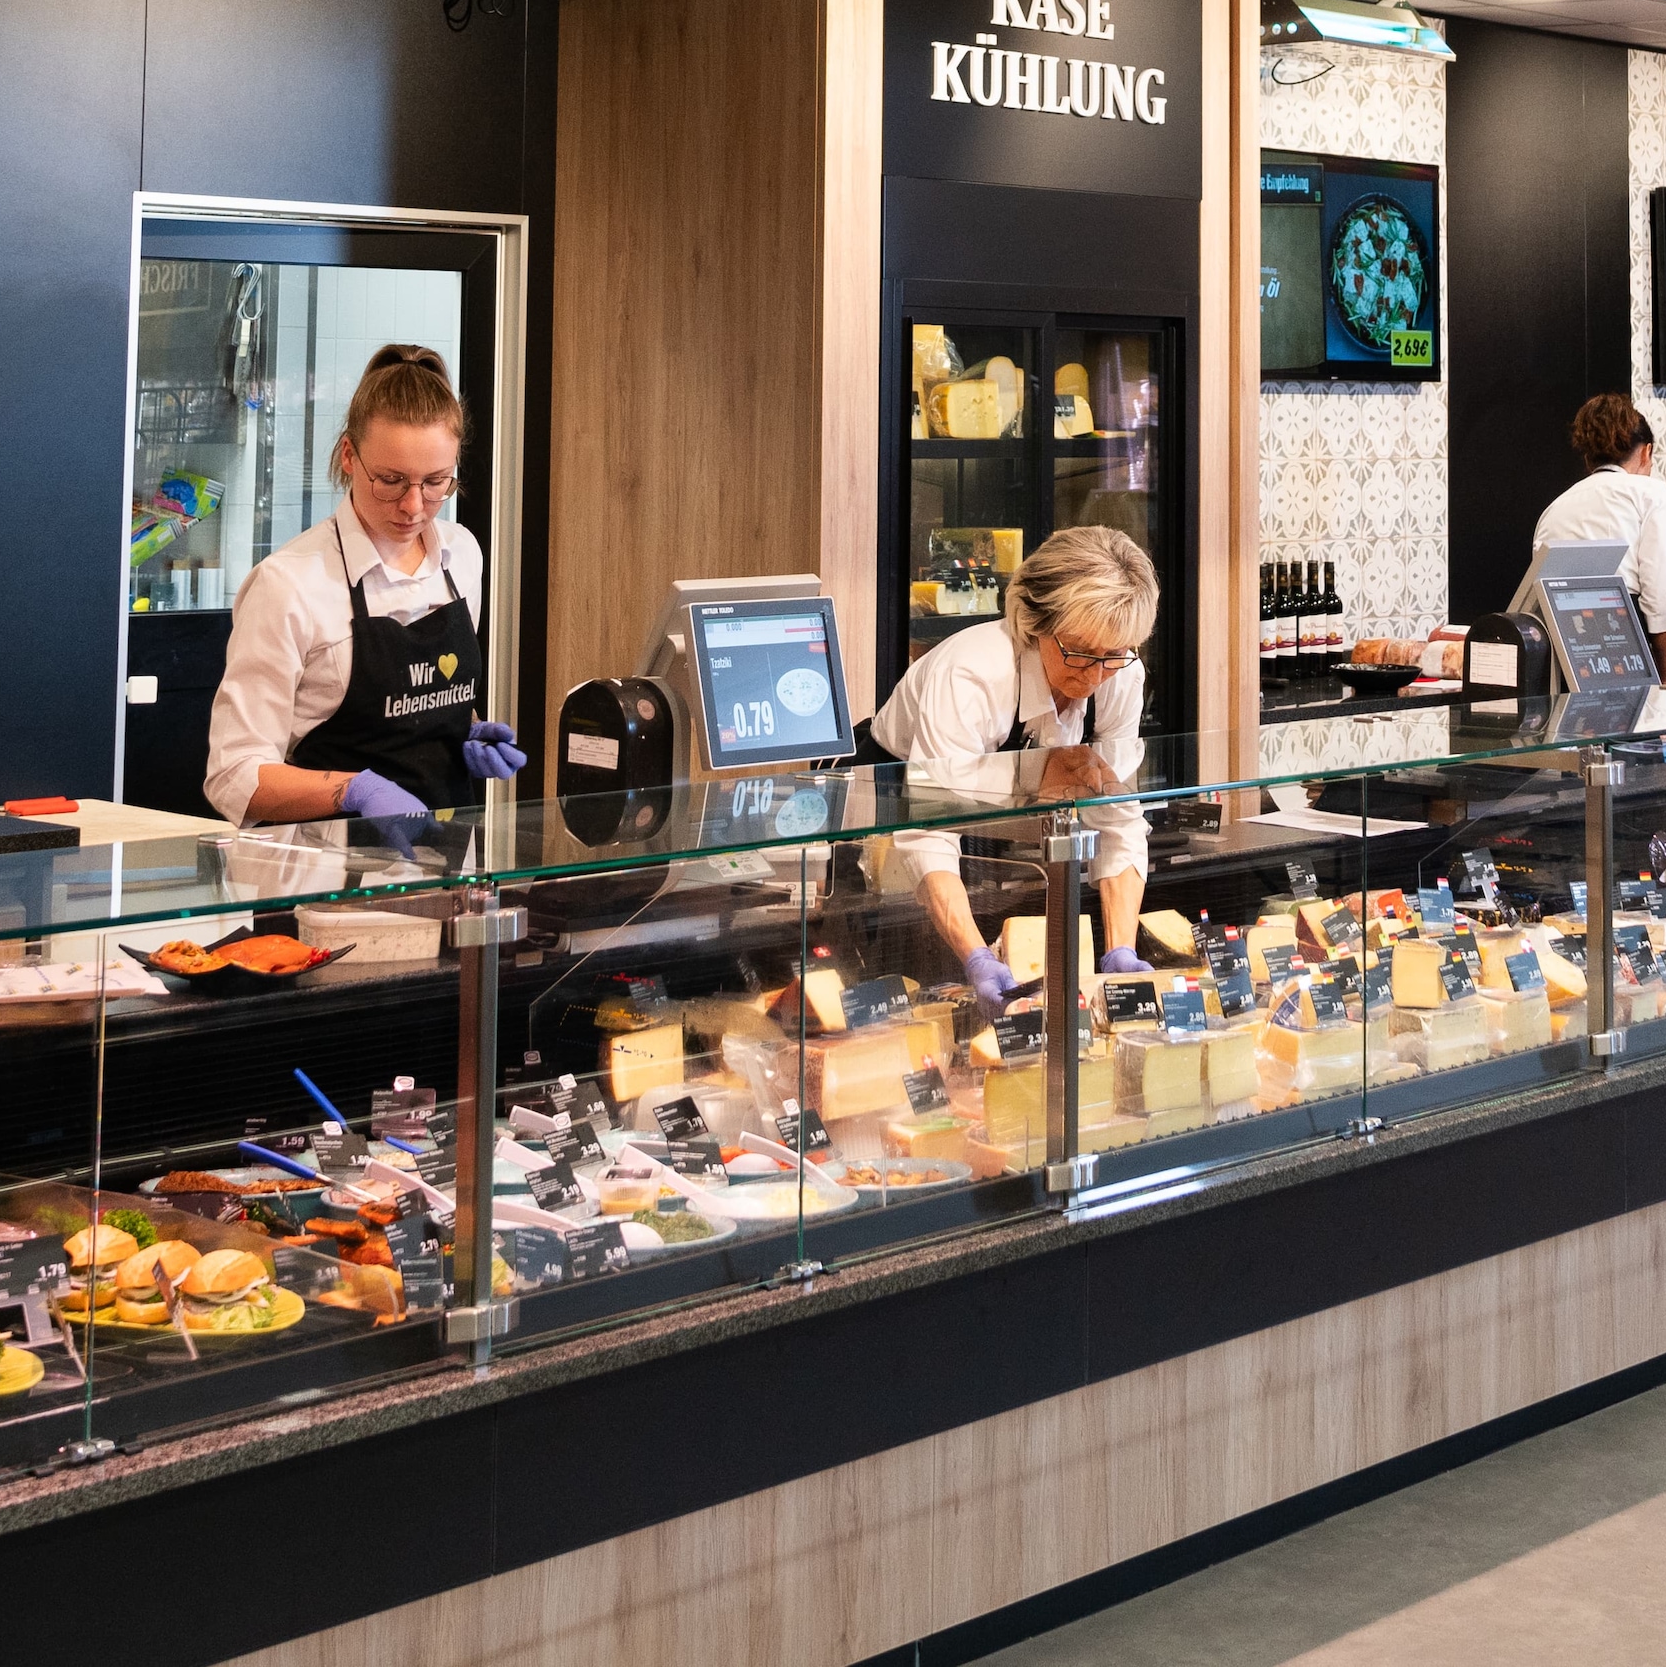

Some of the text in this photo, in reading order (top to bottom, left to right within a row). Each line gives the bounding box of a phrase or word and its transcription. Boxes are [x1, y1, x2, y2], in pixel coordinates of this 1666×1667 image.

[930, 33, 1168, 125] KÜHLUNG
[1266, 173, 1309, 194] Empfehlung
[1266, 278, 1281, 298] Öl
[1393, 339, 1429, 358] 2,69€
[710, 657, 732, 669] Tzatziki
[1589, 657, 1611, 674] 1.49
[1623, 654, 1644, 671] 1.79
[409, 662, 435, 687] Wir
[385, 678, 476, 717] Lebensmittel.
[733, 700, 774, 738] 0.79
[38, 1263, 66, 1278] 1.79
